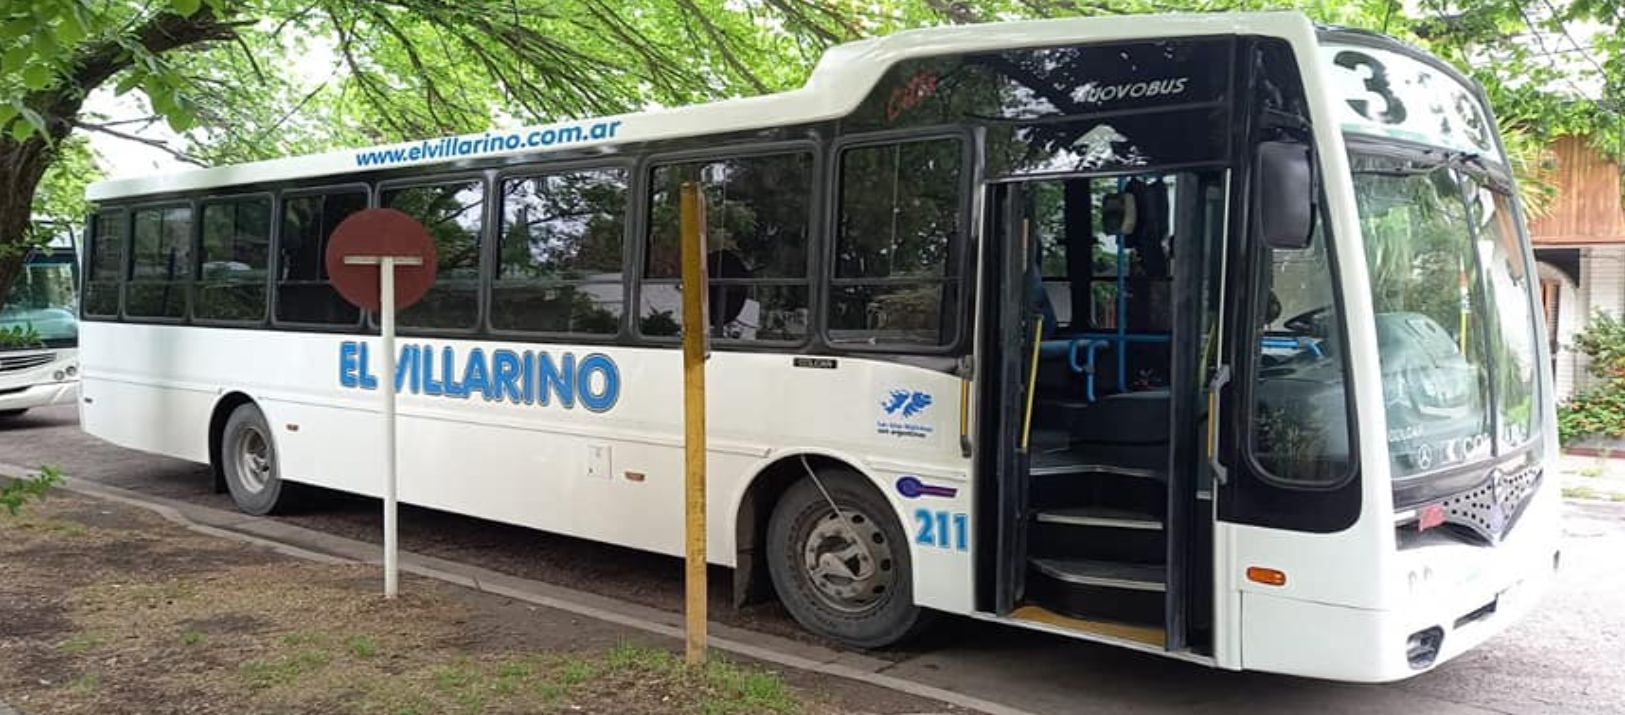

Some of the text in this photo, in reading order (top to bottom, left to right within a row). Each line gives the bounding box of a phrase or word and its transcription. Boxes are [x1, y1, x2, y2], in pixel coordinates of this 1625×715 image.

[1073, 78, 1188, 103] UOVOBUS
[356, 120, 621, 167] www.elvillarino.com.ar
[338, 341, 378, 390] EL
[914, 508, 969, 551] 211
